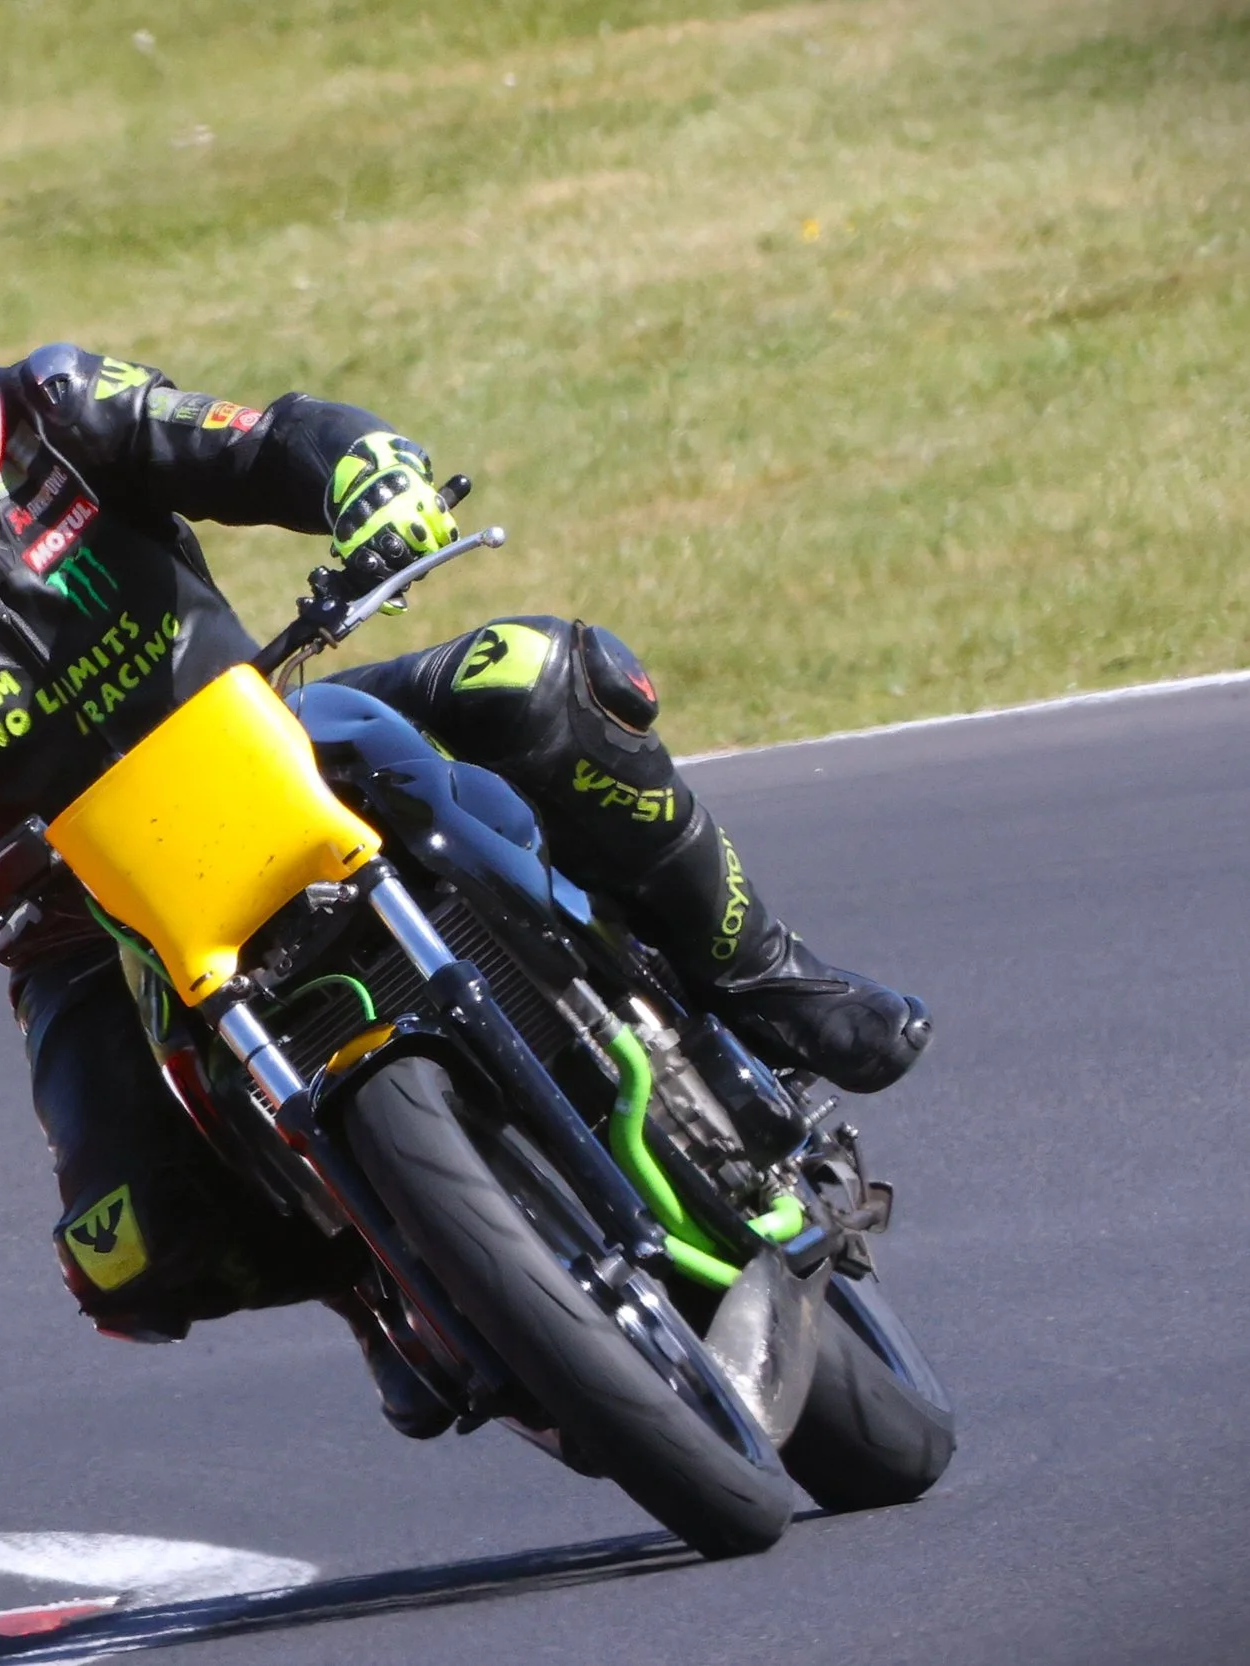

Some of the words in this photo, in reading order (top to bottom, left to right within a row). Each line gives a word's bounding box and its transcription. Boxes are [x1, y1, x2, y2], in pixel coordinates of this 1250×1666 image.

[29, 502, 92, 571] MOTUL
[35, 611, 140, 715] LIMITS
[75, 612, 180, 735] RACING
